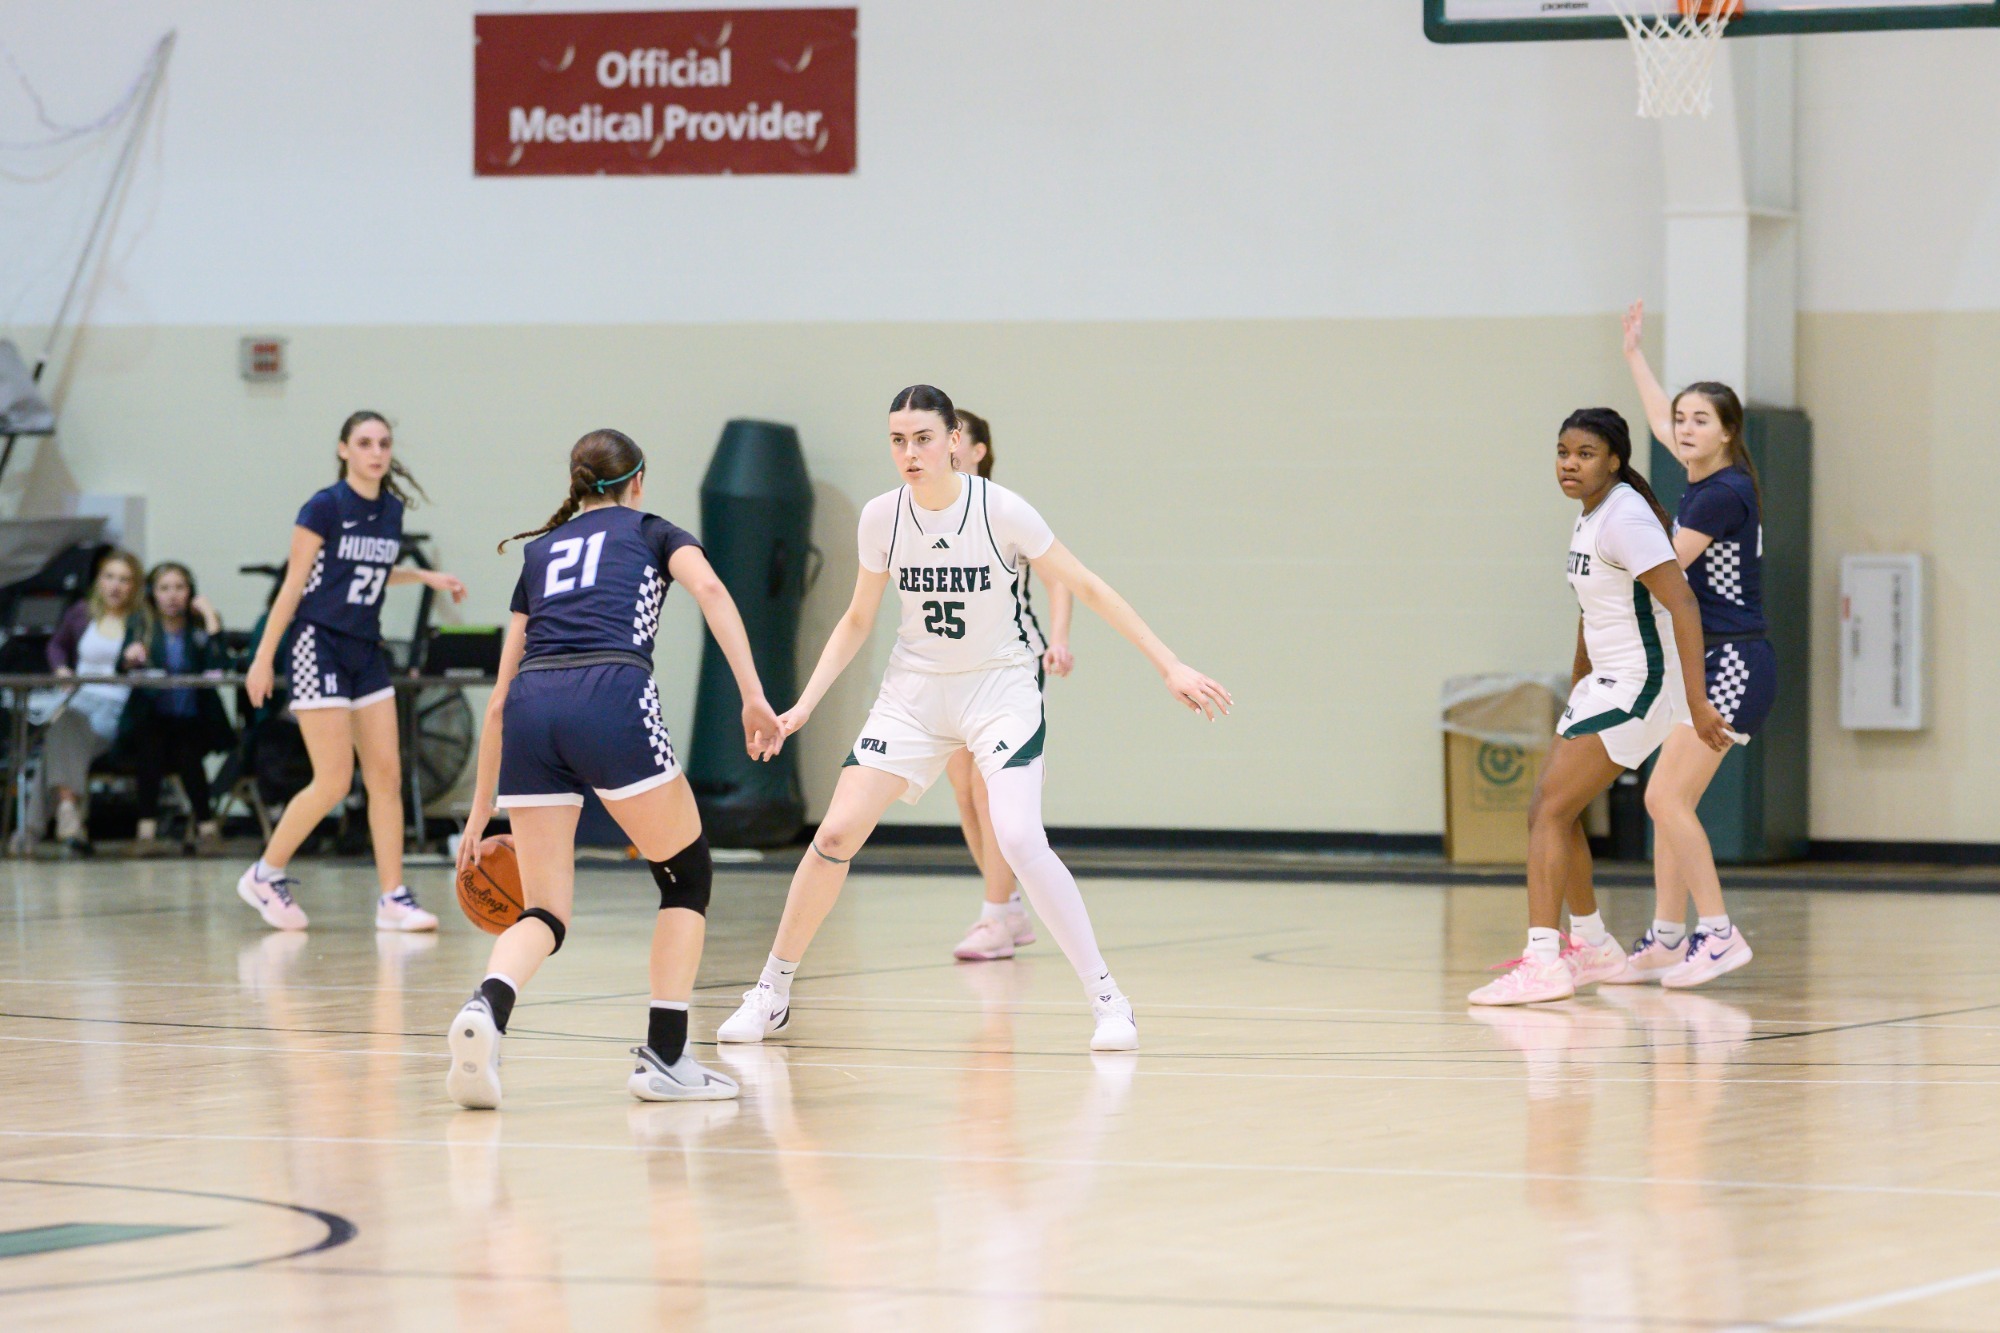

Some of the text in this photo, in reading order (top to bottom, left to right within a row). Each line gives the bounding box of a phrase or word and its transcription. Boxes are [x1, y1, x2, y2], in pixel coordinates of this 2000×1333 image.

[596, 48, 732, 88] Official
[509, 102, 823, 143] Medical Provider
[543, 531, 607, 598] 21
[899, 565, 991, 592] RESERVE
[347, 565, 387, 606] 23
[922, 601, 966, 639] 25
[860, 738, 888, 755] WRA
